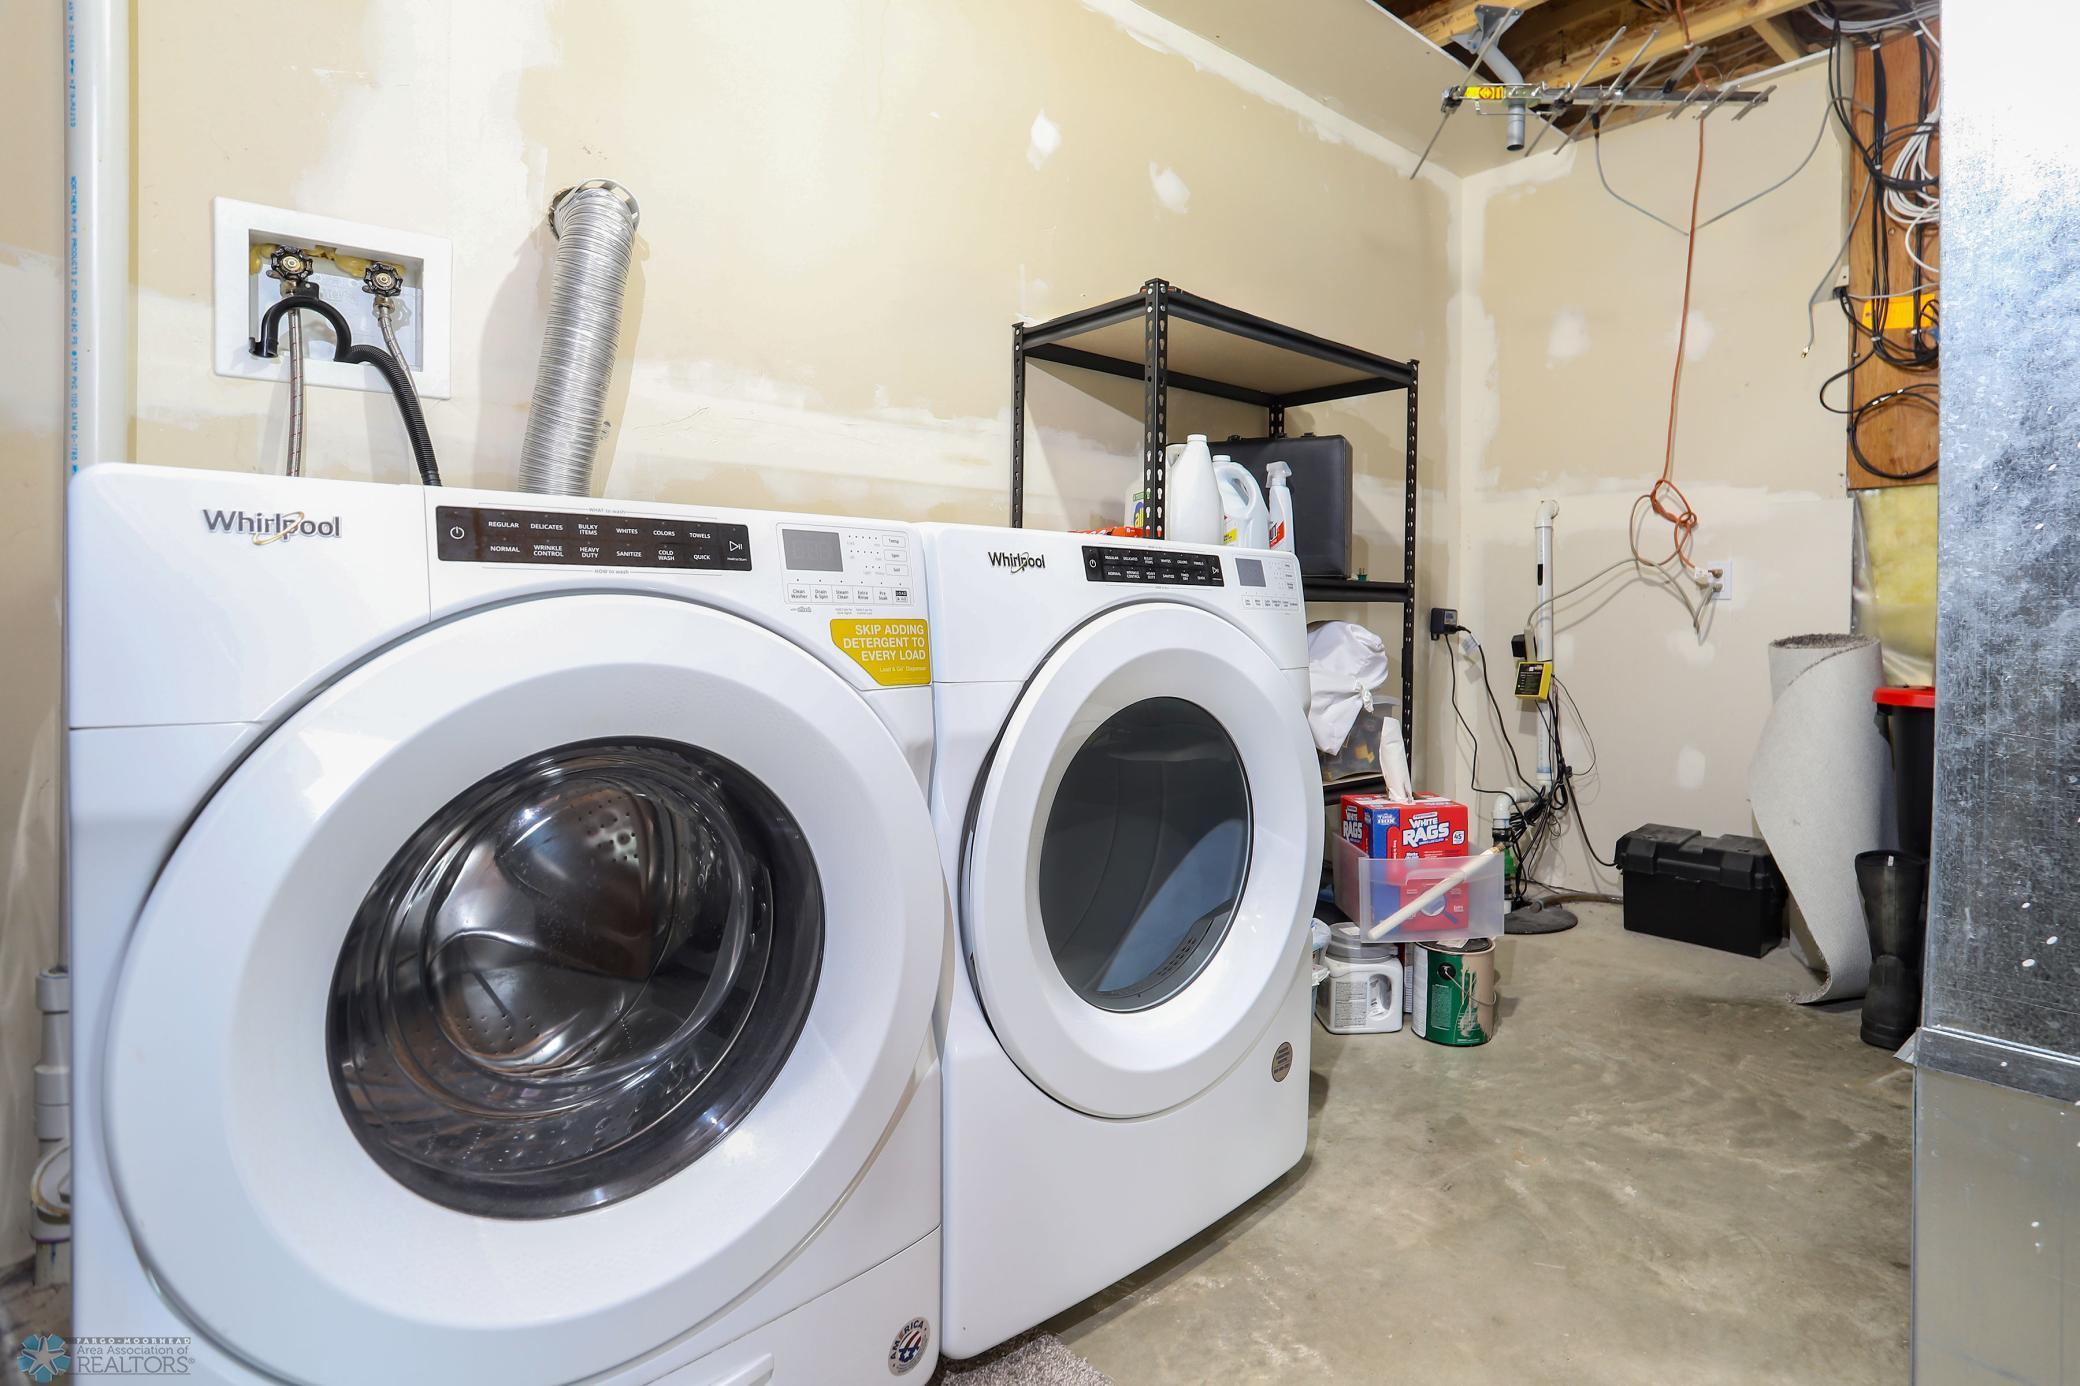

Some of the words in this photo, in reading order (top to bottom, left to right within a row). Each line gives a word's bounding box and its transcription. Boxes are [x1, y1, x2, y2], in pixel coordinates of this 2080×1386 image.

[70, 176, 79, 215] NORTHERN
[70, 218, 79, 234] PIPE
[70, 238, 79, 276] PRODUCTS
[202, 509, 342, 542] Whirlpool
[488, 521, 520, 529] REGULAR
[530, 523, 564, 531] DELICATES
[490, 545, 521, 553] NORMAL
[616, 550, 642, 558] SANITIZE
[987, 551, 1046, 573] Whirlpool
[855, 624, 881, 636] SKIP
[884, 624, 924, 636] ADDING
[843, 637, 909, 649] DETERGENT
[911, 637, 925, 648] TO
[861, 650, 896, 662] EVERY
[899, 650, 926, 661] LOAD
[1408, 817, 1439, 829] WHITE
[1343, 820, 1363, 842] RAGS
[1402, 822, 1450, 848] RAGS
